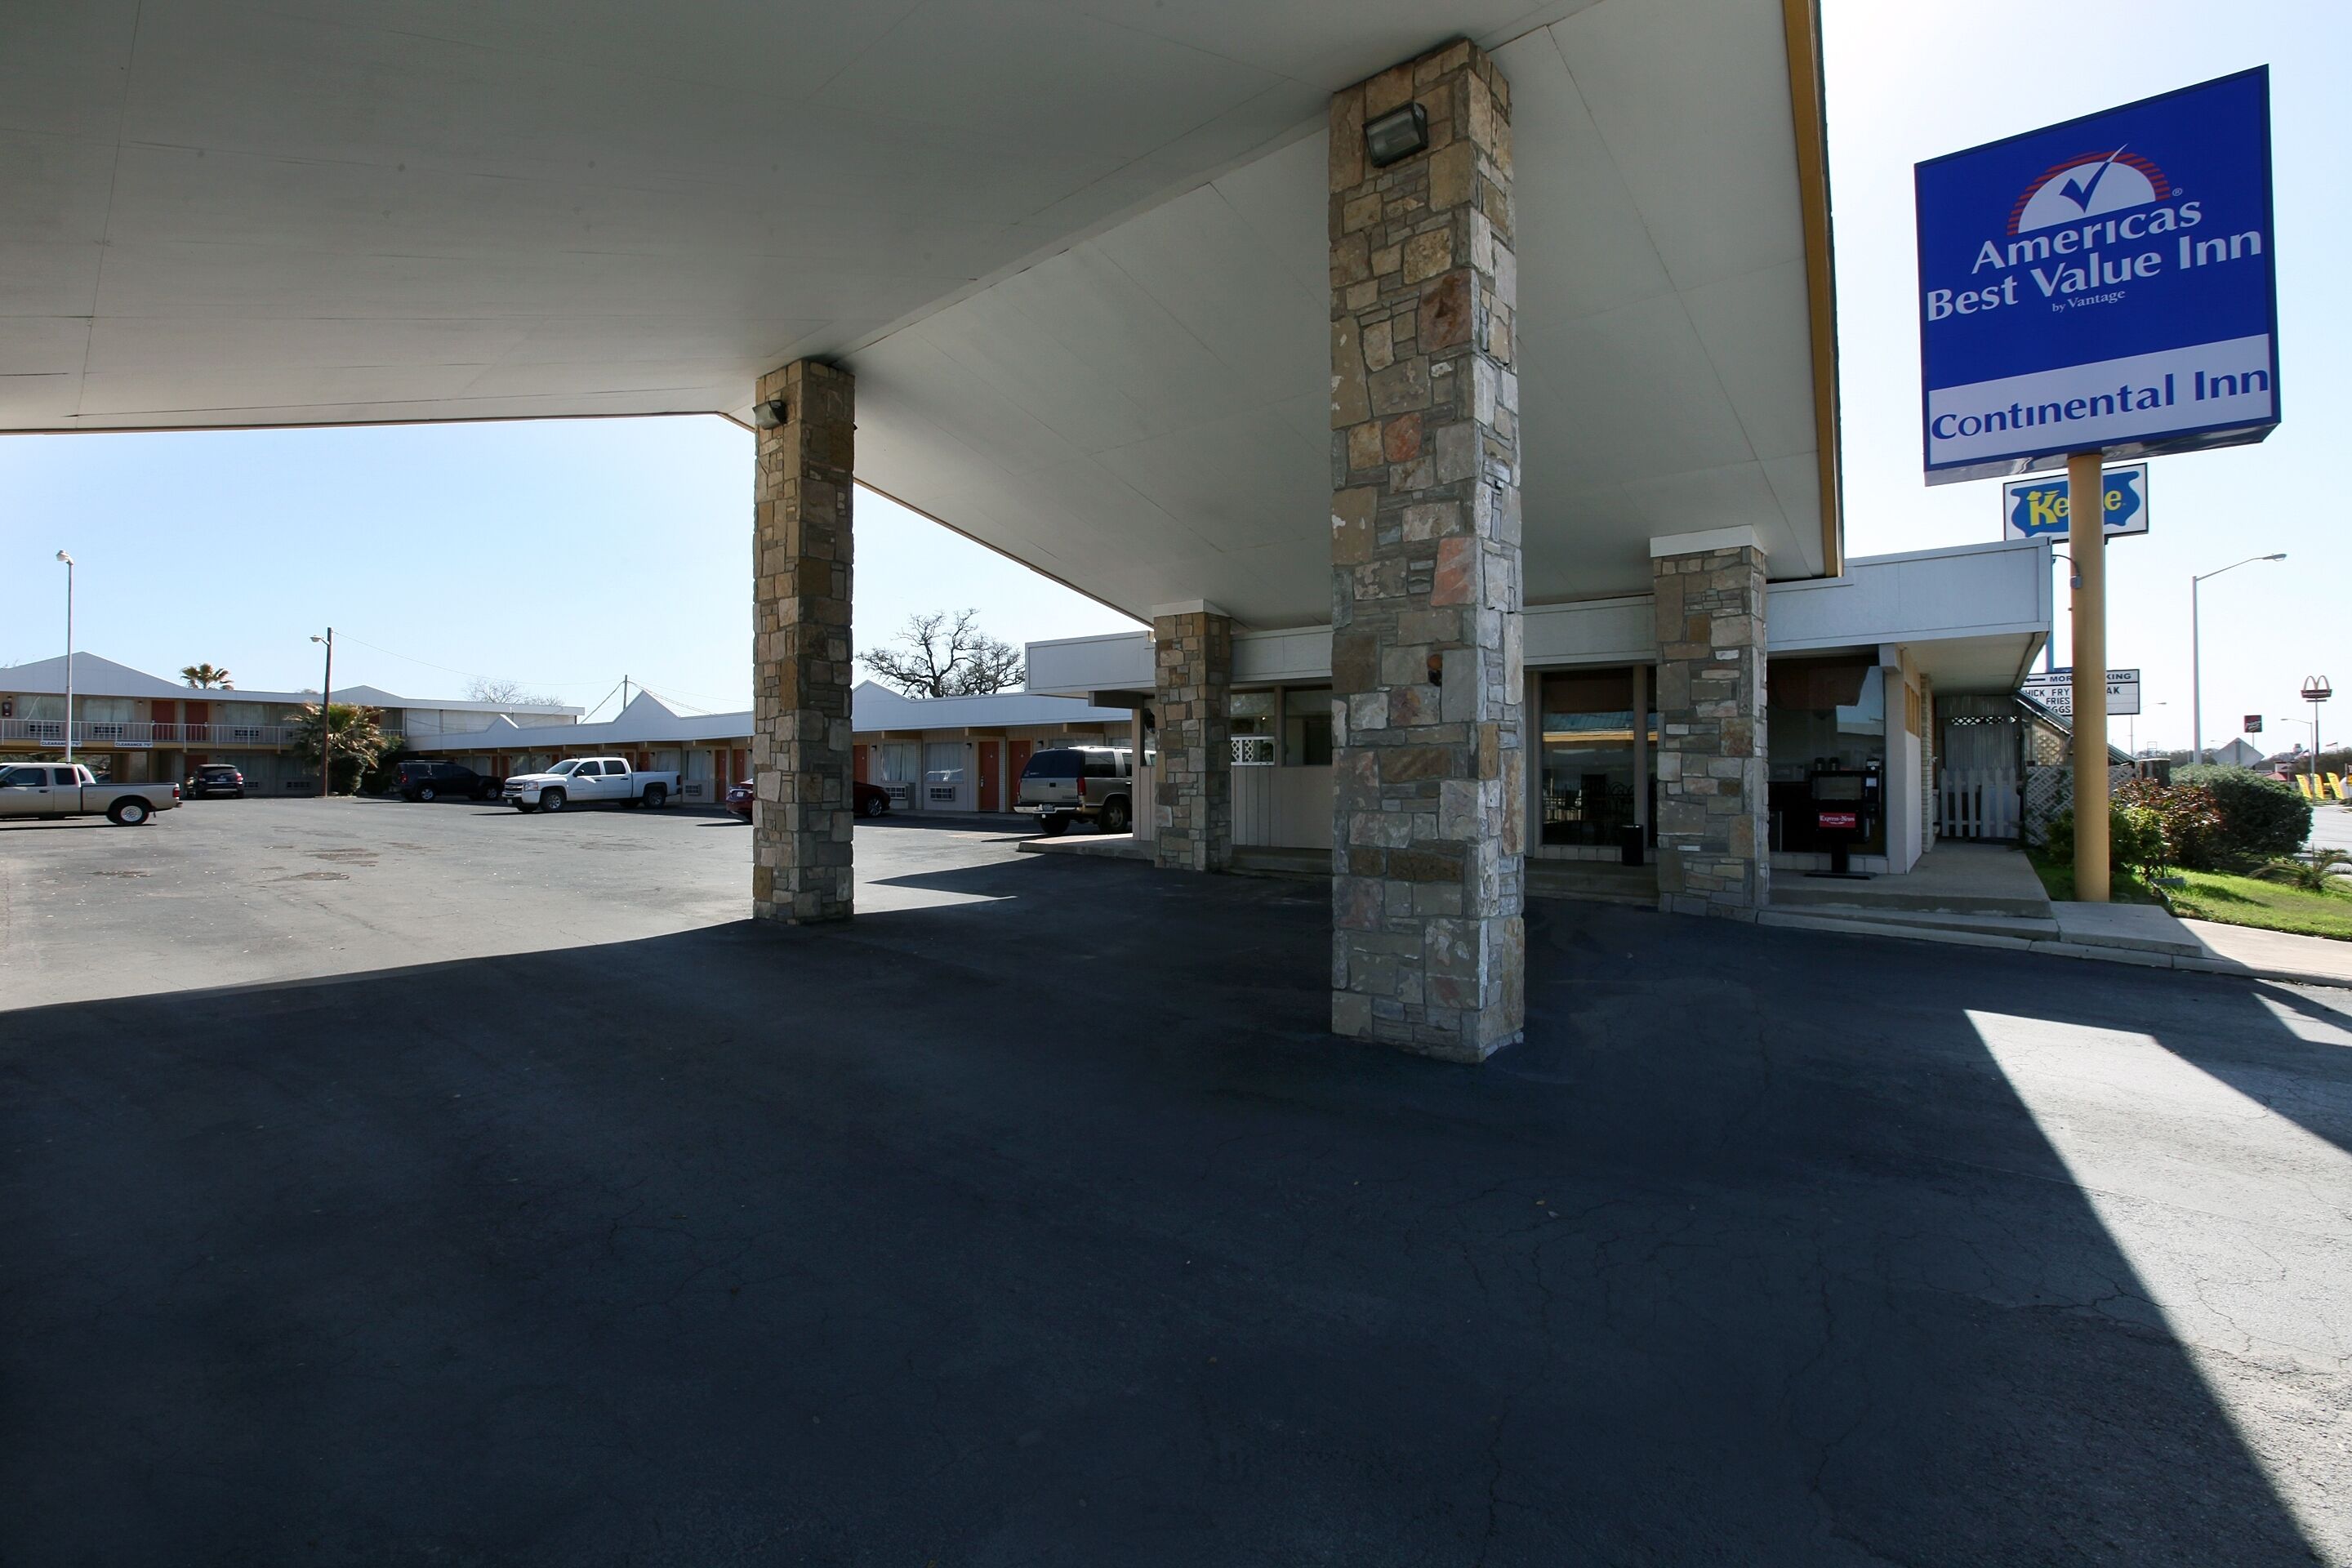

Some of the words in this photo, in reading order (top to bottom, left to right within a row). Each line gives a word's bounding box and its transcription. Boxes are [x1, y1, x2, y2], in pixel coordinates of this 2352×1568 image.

[1971, 201, 2202, 274] Americas
[1927, 275, 2019, 322] Best
[2030, 252, 2162, 297] Value
[2179, 231, 2261, 270] Inn
[2052, 303, 2066, 313] by
[2067, 290, 2126, 308] Vantage
[1931, 373, 2175, 440] Continental
[2194, 369, 2269, 402] Inn
[2024, 688, 2045, 697] HICK
[2051, 688, 2069, 697] FRY
